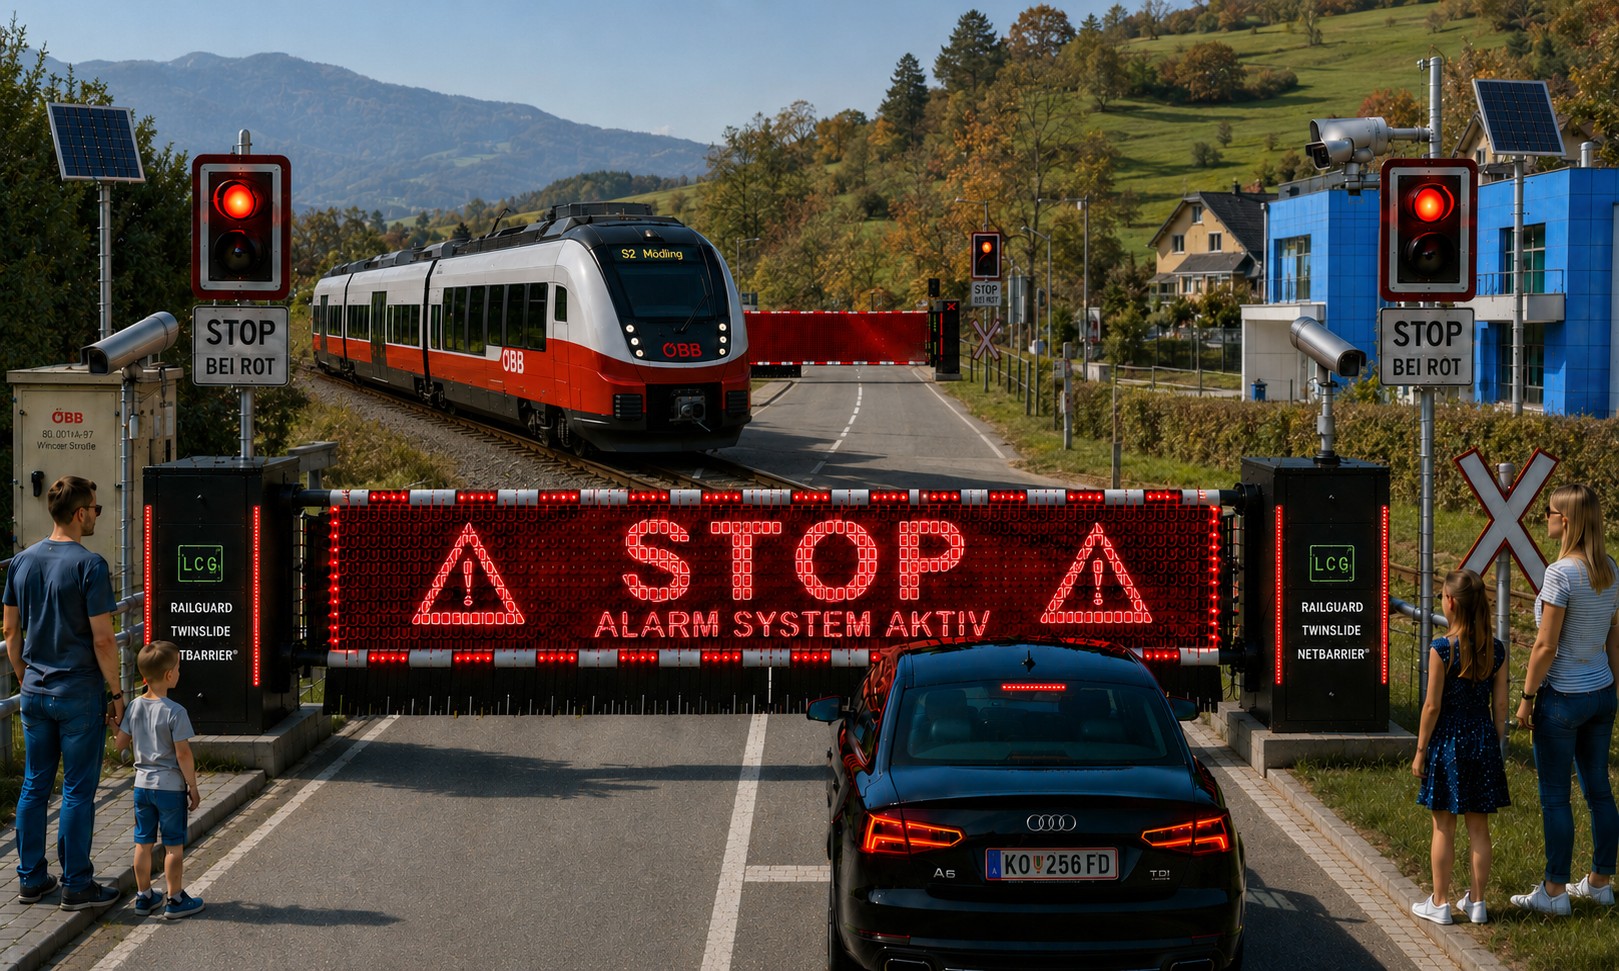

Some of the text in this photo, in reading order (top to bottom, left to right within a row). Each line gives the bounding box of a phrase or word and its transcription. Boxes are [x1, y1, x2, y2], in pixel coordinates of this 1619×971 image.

[621, 248, 683, 261] S2 Mödling
[974, 284, 998, 295] STOP
[206, 319, 276, 345] STOP
[1393, 320, 1463, 347] STOP
[662, 342, 702, 358] ÖBB
[206, 357, 276, 375] BEI ROT
[502, 349, 525, 374] ÖBB
[1393, 357, 1462, 376] BEI ROT
[52, 408, 83, 424] ÖBB
[183, 556, 217, 571] LCG
[622, 519, 965, 601] STOP
[1315, 556, 1349, 571] LCG
[170, 602, 233, 613] RAILGUARD
[1301, 601, 1364, 612] RAILGUARD
[170, 625, 231, 637] TWINSLIDE
[595, 610, 991, 637] ALARM SYSTEM AKTIV
[1301, 625, 1361, 636] TWINSLIDE
[179, 649, 239, 661] TBARRIER®
[1004, 854, 1110, 875] KO 256 FD
[933, 867, 956, 879] A6
